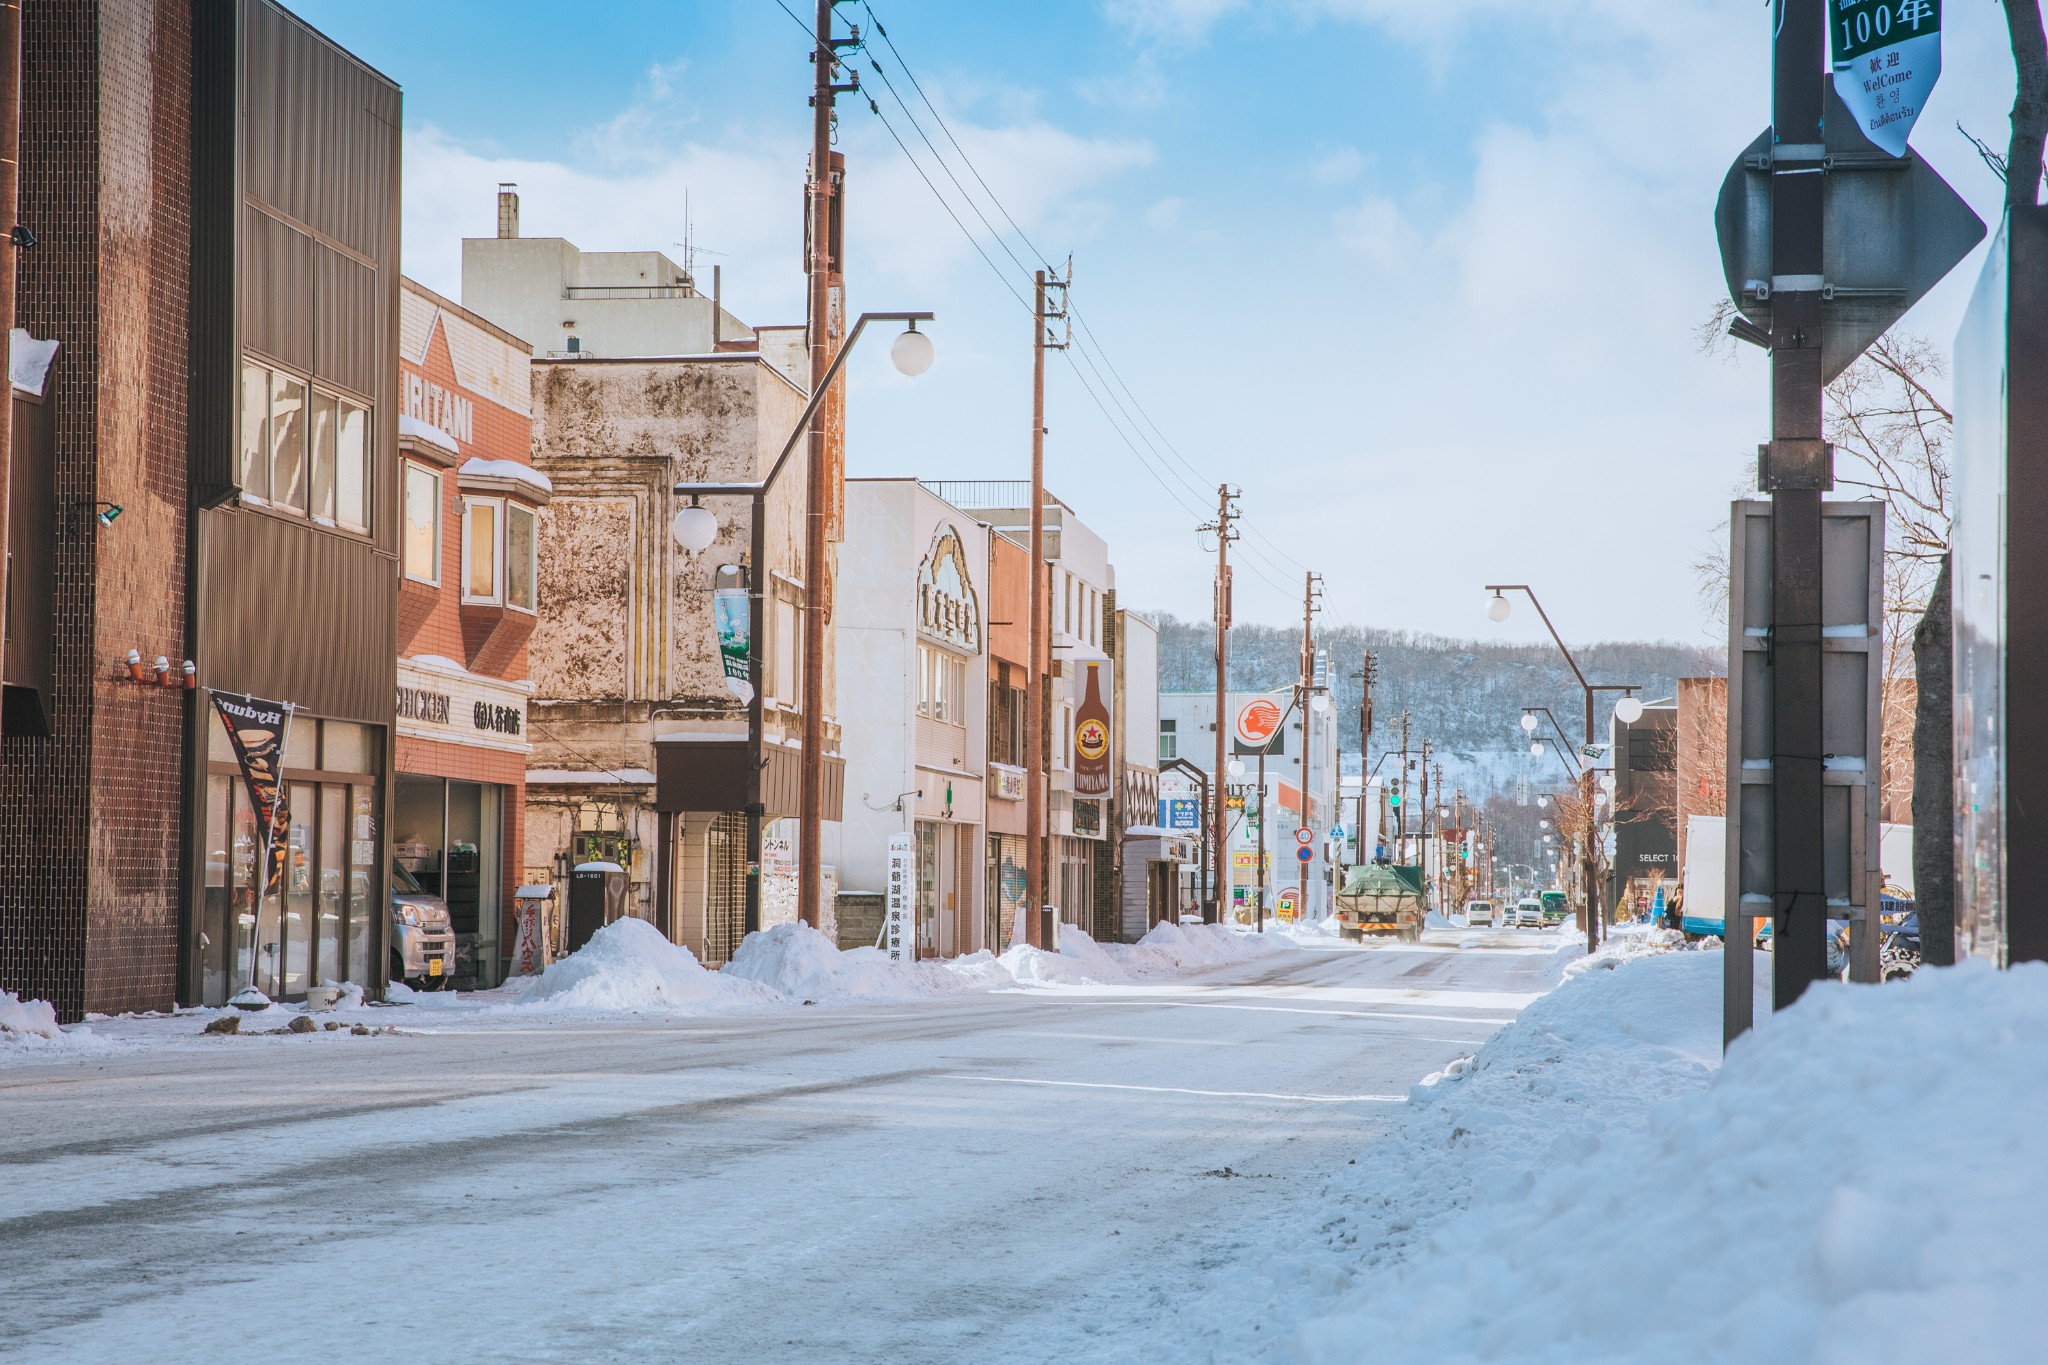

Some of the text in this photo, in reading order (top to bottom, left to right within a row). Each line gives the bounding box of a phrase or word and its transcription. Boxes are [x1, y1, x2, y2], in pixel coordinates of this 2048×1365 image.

[1841, 0, 1934, 51] 100年
[1863, 69, 1913, 94] WelCome
[404, 370, 473, 446] IRITANI
[1075, 772, 1109, 791] TOMIYAMA
[1639, 854, 1669, 862] SELECT
